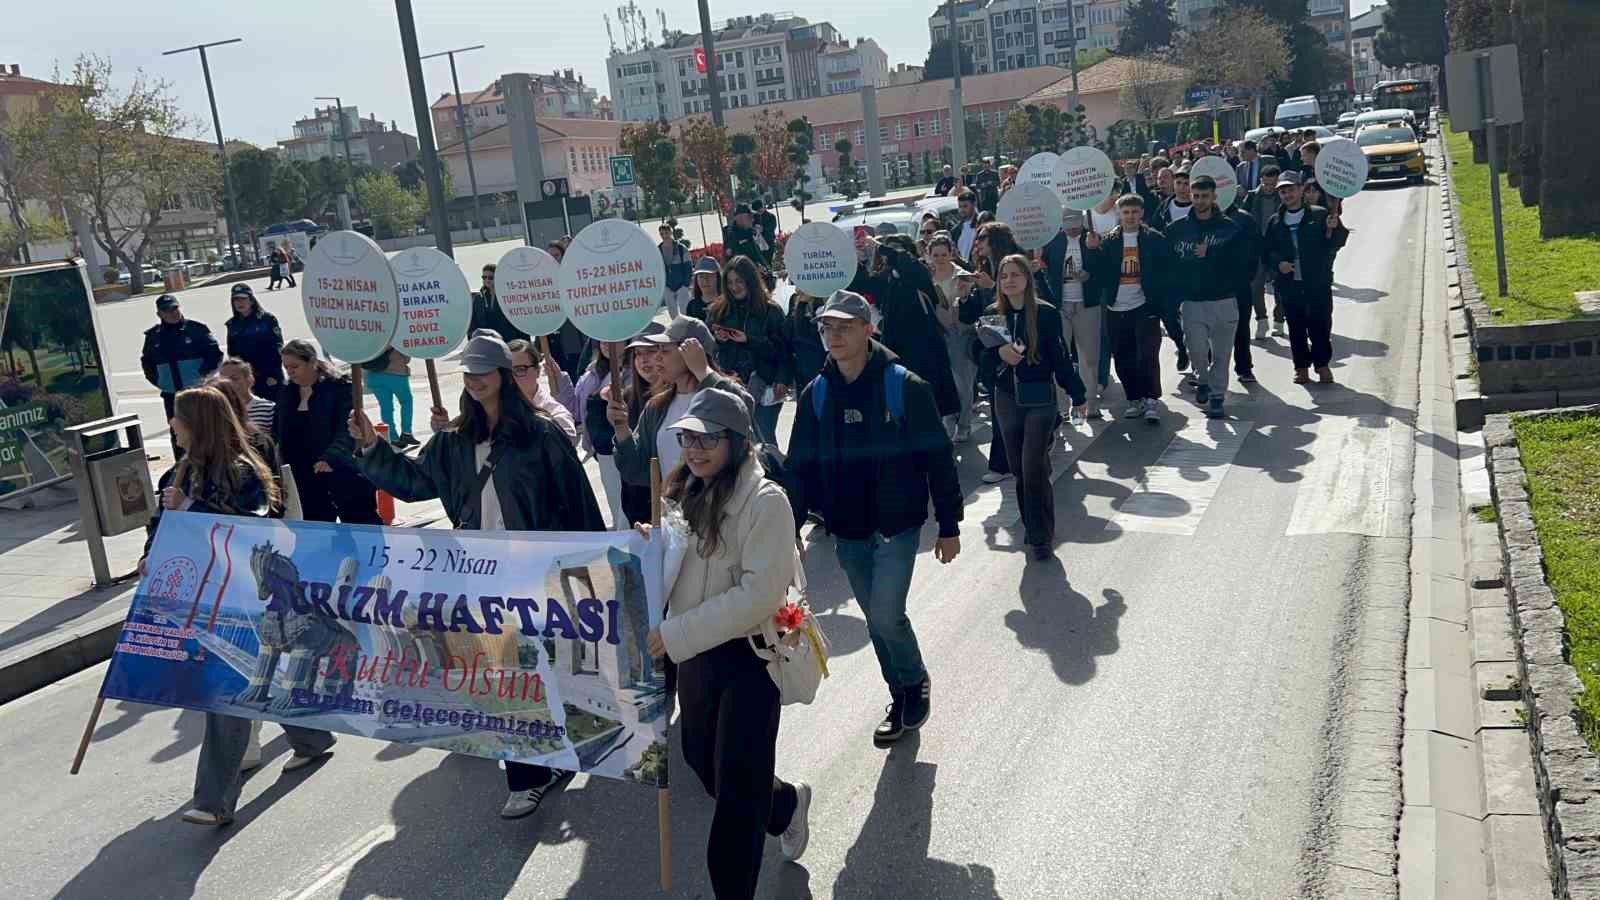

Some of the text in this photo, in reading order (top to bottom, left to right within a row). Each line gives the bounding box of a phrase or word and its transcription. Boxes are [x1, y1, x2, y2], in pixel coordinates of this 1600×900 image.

[576, 260, 643, 281] 15-22 NİSAN
[317, 275, 377, 293] 15-22 NİSAN
[411, 280, 440, 292] AKAR
[566, 283, 607, 300] TURİZM
[308, 293, 389, 313] TURİZM HAFTASI
[403, 294, 449, 307] BIRAKIR,
[528, 289, 561, 301] HAFTAS
[402, 307, 440, 321] TURİST
[574, 303, 610, 317] KUTLU
[313, 316, 346, 330] KUTLU
[409, 321, 440, 334] DÖVİZ
[367, 545, 391, 569] 15
[410, 547, 438, 572] 22
[441, 548, 498, 576] Nisan
[264, 574, 621, 646] TURİZM HAFTASI
[319, 642, 547, 704] Kutlu Olsun
[382, 698, 568, 740] Geleceğimizdir
